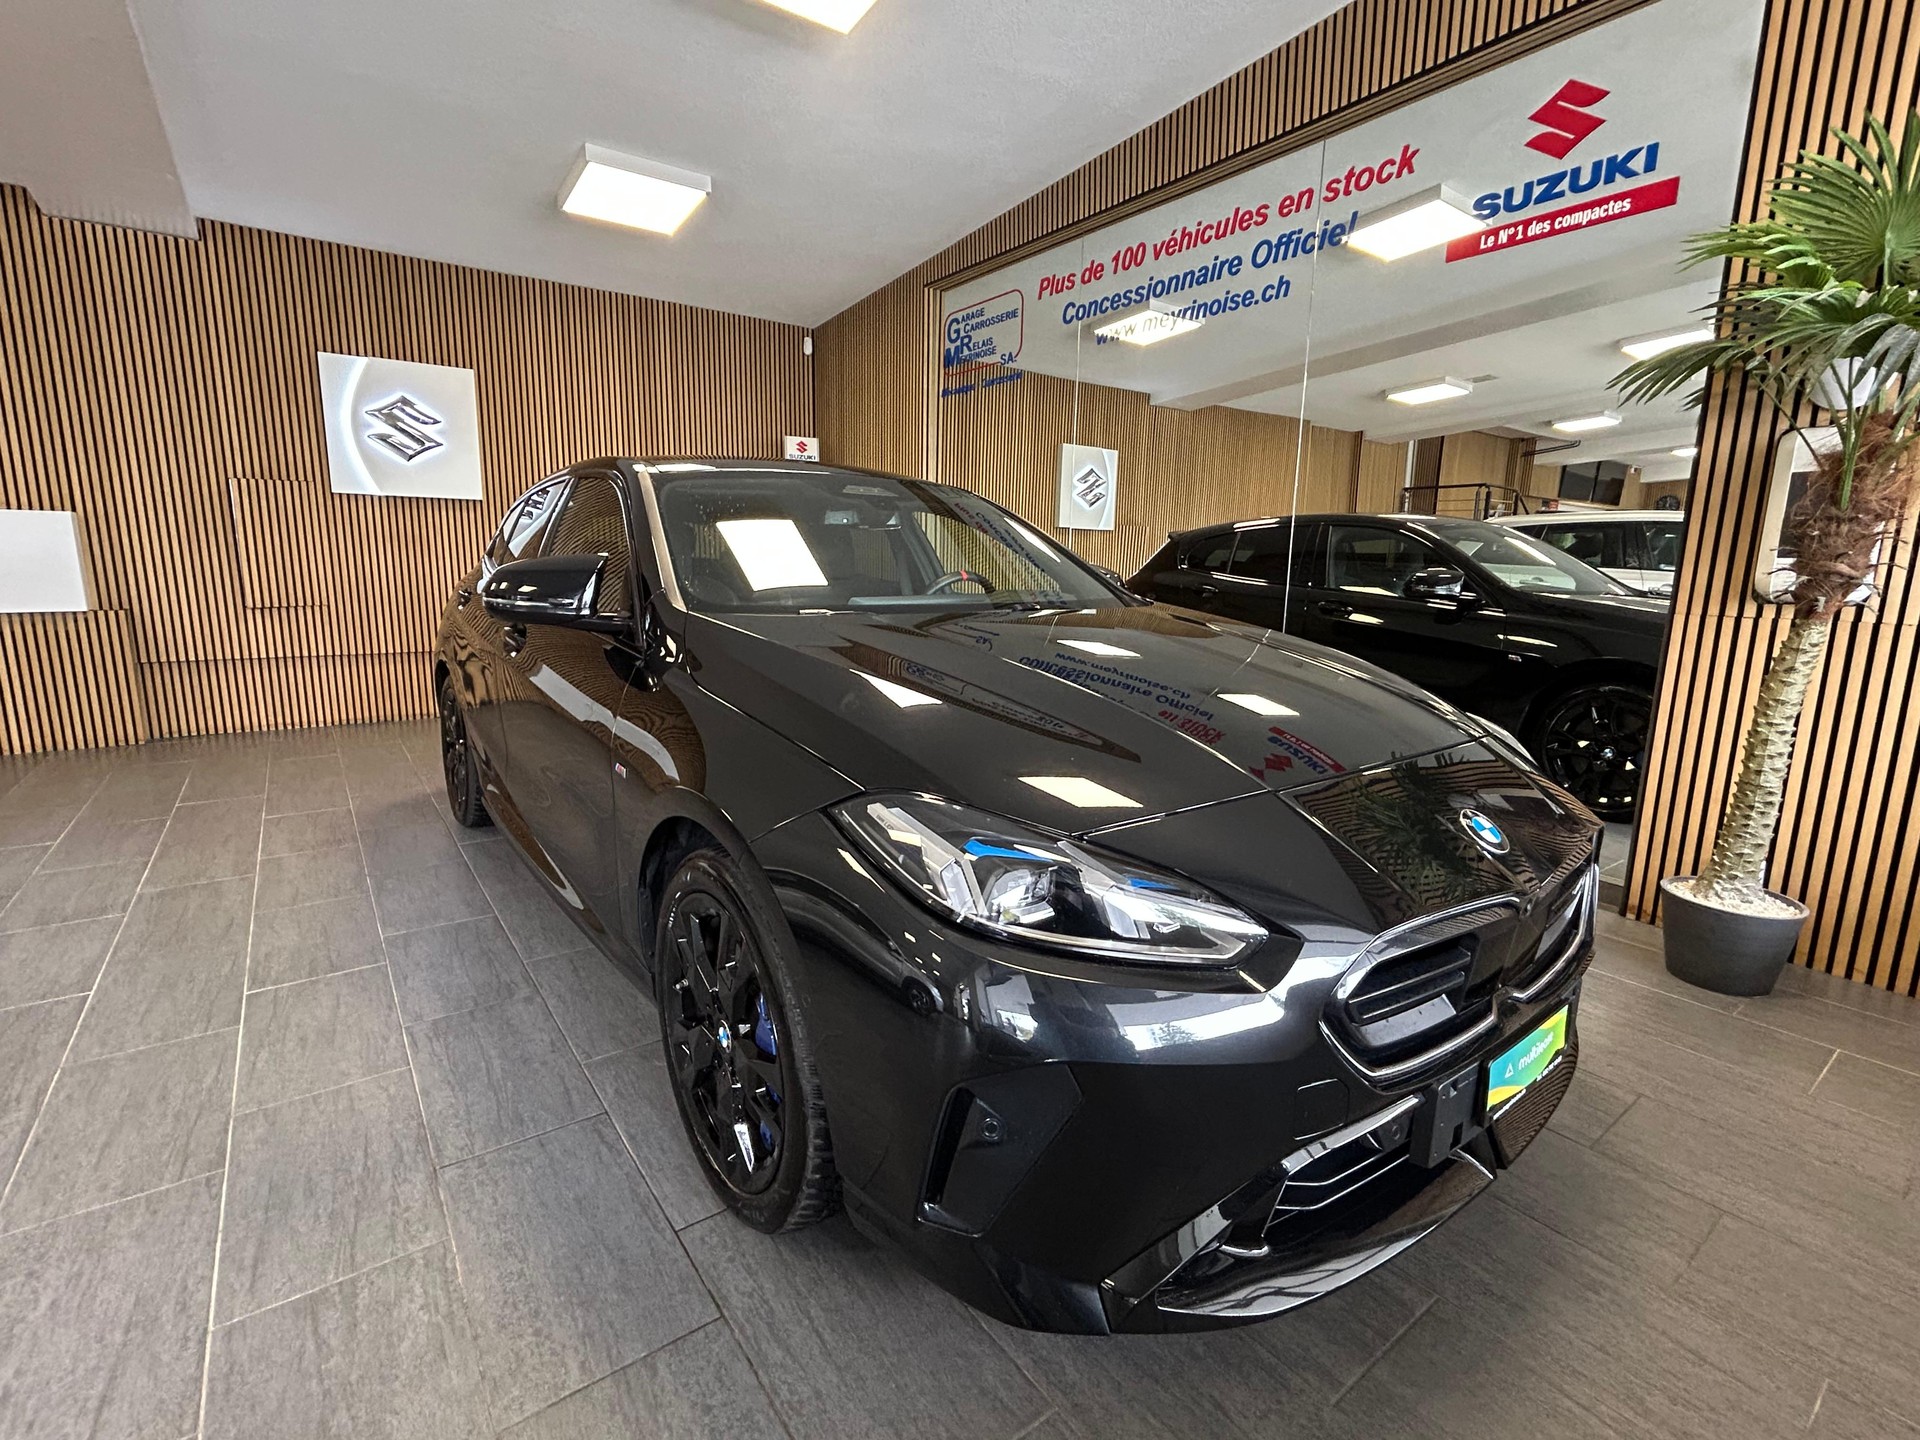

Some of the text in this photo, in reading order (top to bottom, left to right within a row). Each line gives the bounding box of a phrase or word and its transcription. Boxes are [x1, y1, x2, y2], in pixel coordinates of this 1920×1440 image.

[1472, 142, 1660, 220] SUZUKI
[1038, 144, 1420, 300] Plus de 100 véhicules en stock
[1480, 234, 1495, 249] Le
[1527, 219, 1551, 237] des
[1554, 198, 1632, 228] compactes
[1062, 210, 1359, 325] Concessionnaire Officiel
[960, 334, 994, 354] RELAIS
[963, 308, 1019, 334] CARROSSERIE
[1096, 274, 1292, 345] wwwmeyrinoise.ch
